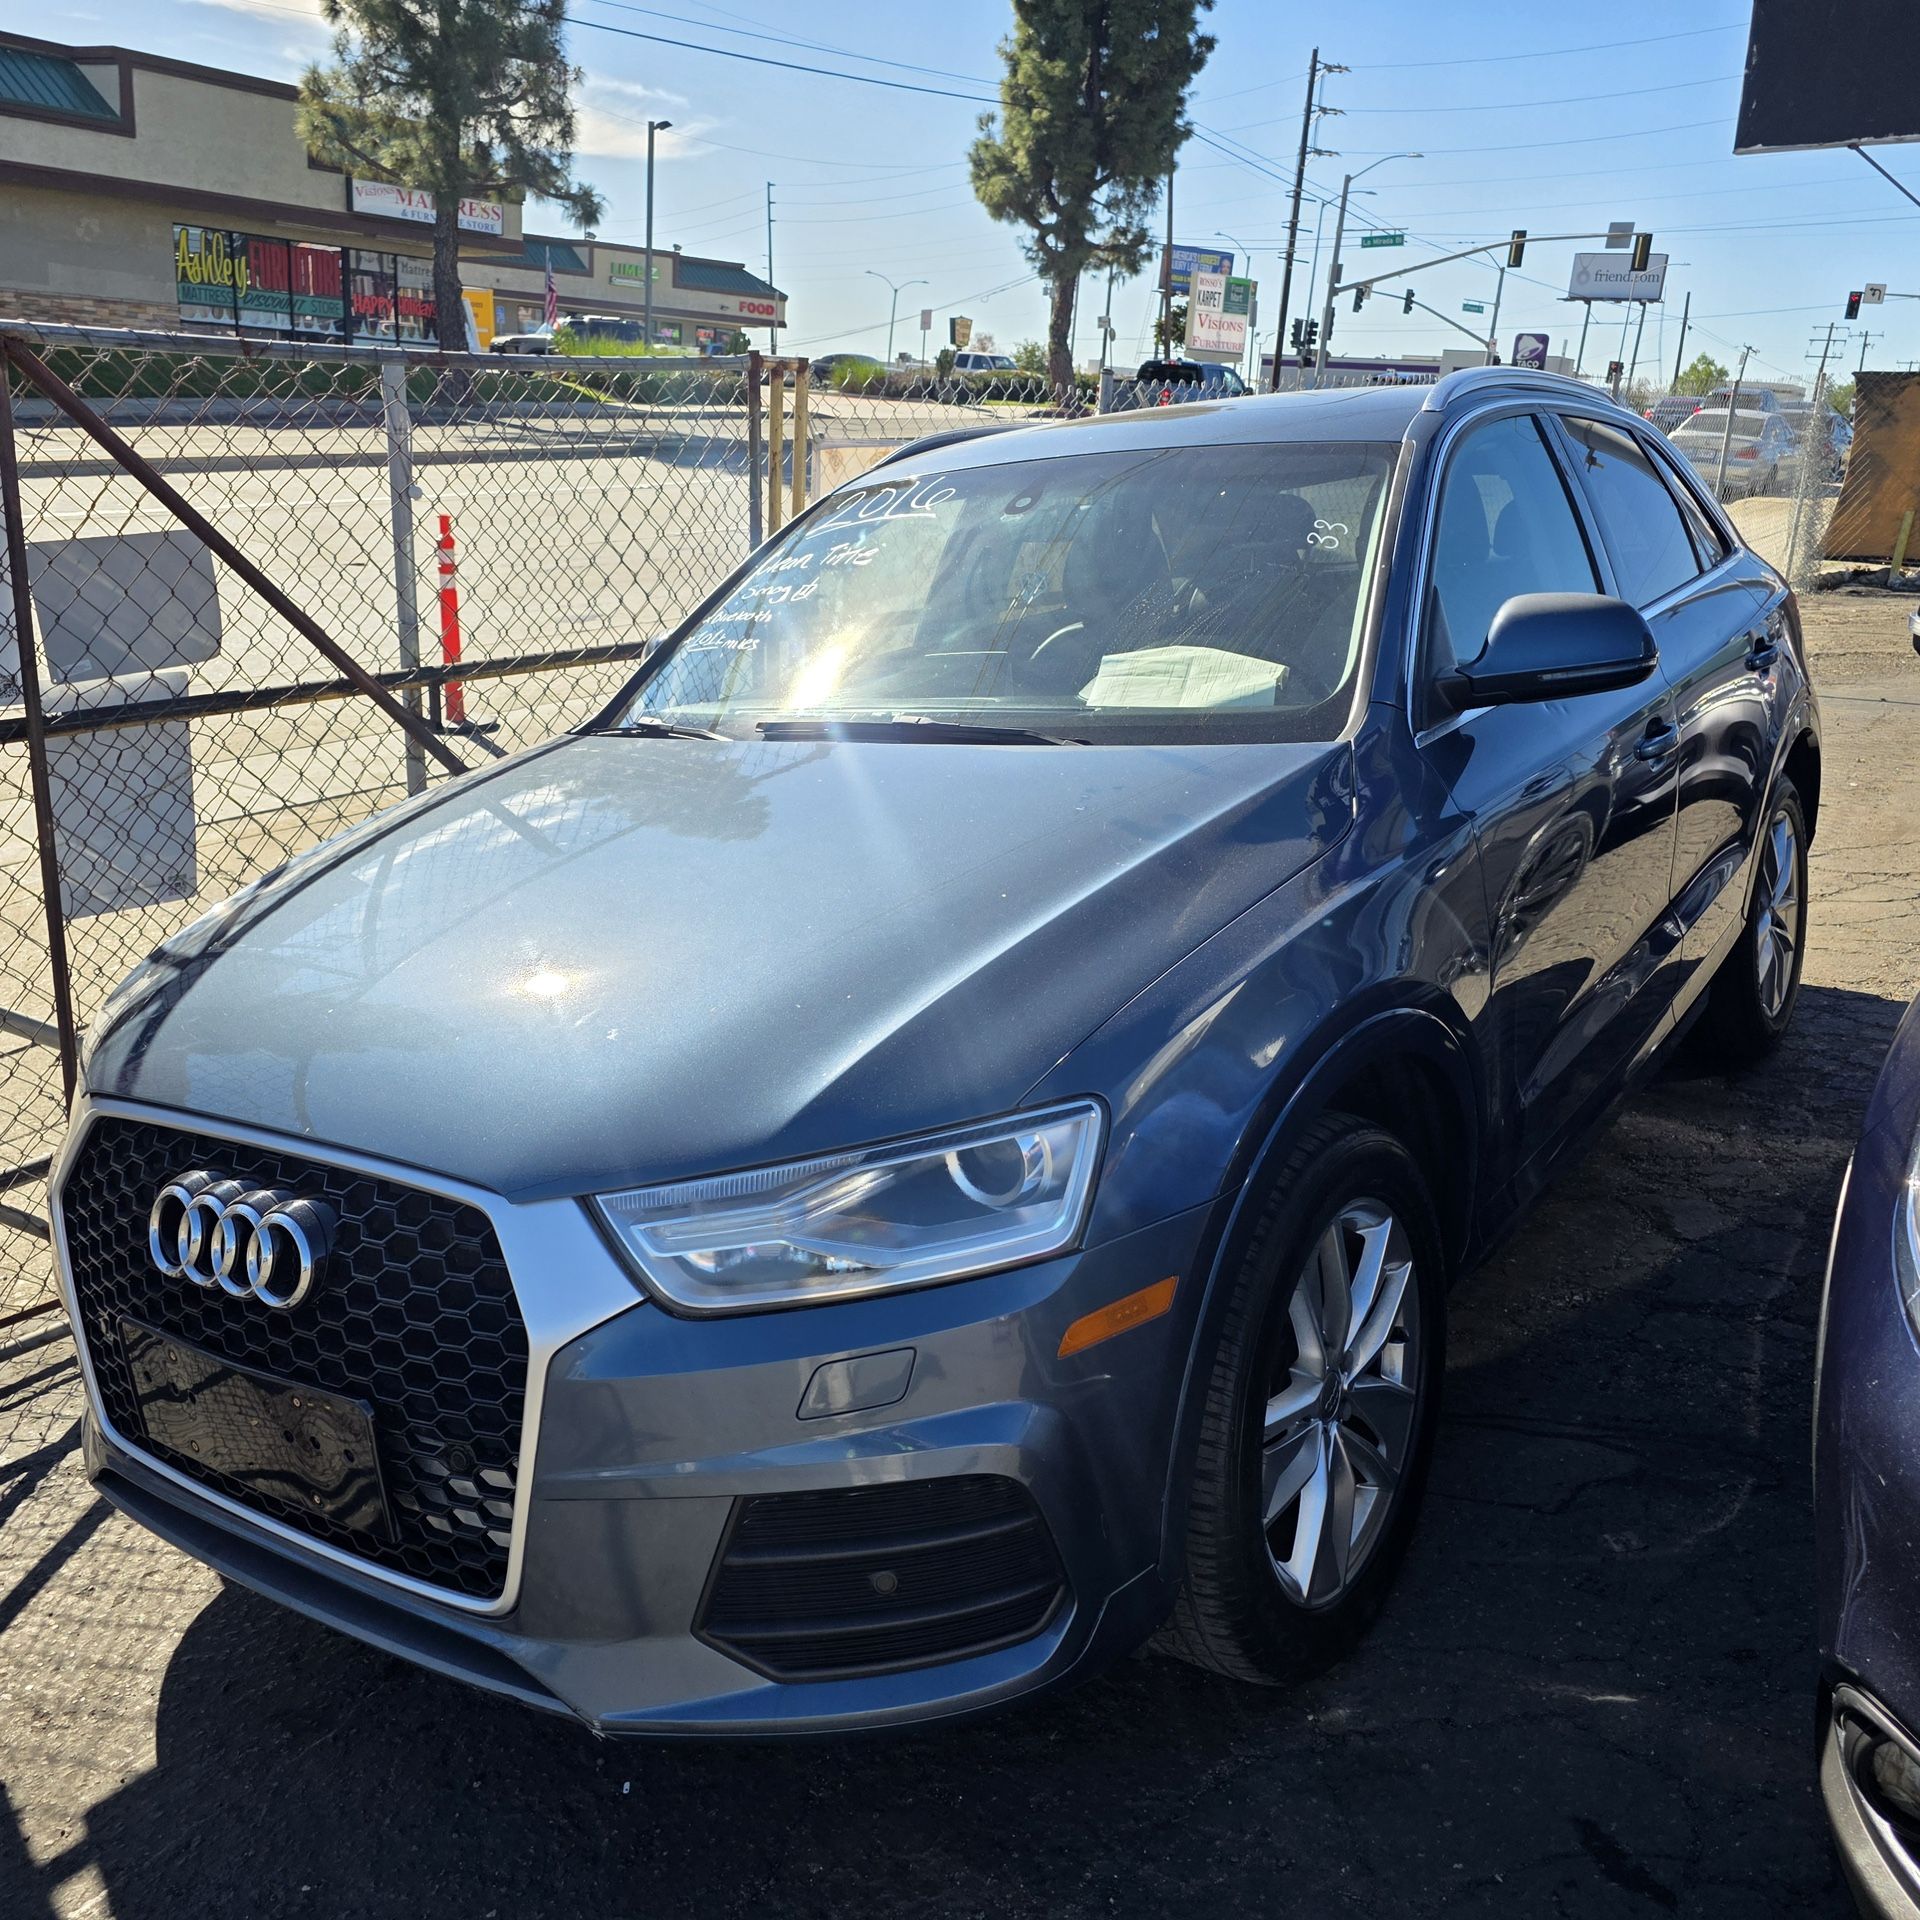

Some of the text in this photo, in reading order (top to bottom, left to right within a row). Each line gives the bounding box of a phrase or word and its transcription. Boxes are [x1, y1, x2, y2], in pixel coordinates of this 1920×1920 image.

[395, 188, 502, 221] MATRESS
[467, 219, 497, 233] STORE
[178, 227, 247, 297] Ashley
[180, 285, 342, 315] MATTRESS DISCOUNT STORE
[352, 293, 393, 318] HAPPY
[738, 301, 775, 316] FOOD
[1516, 360, 1541, 368] TACO
[805, 476, 956, 537] 2016
